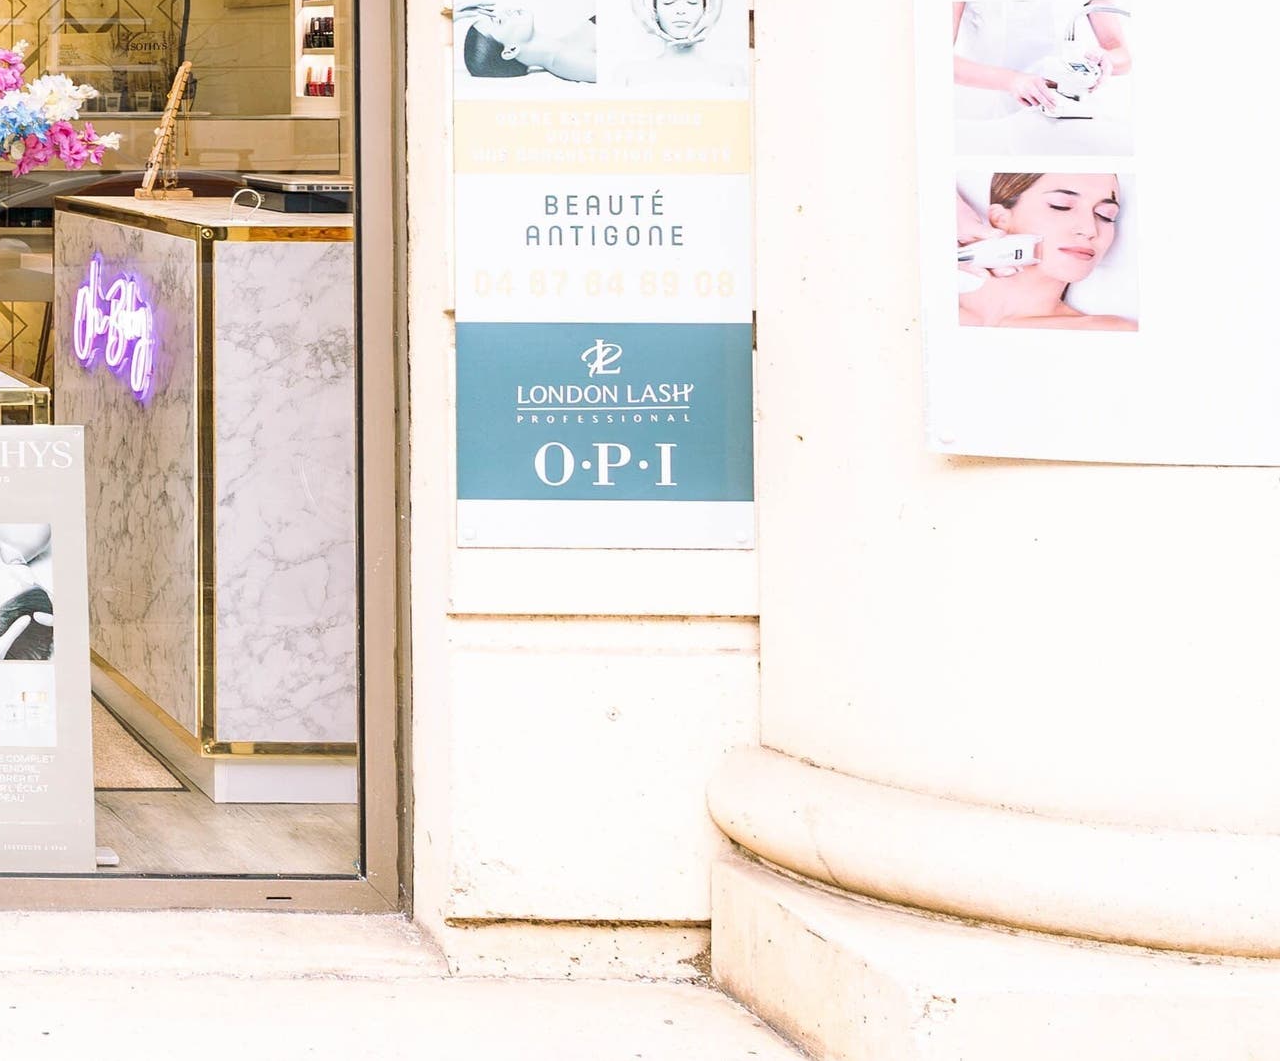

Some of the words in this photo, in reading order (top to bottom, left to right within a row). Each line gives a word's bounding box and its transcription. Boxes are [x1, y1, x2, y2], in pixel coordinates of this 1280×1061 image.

[544, 189, 665, 216] BEAUTÉ
[525, 225, 684, 246] ANTIGONE
[516, 385, 619, 405] LONDON
[627, 383, 695, 403] LASH
[516, 413, 691, 424] PROFESSIONAL
